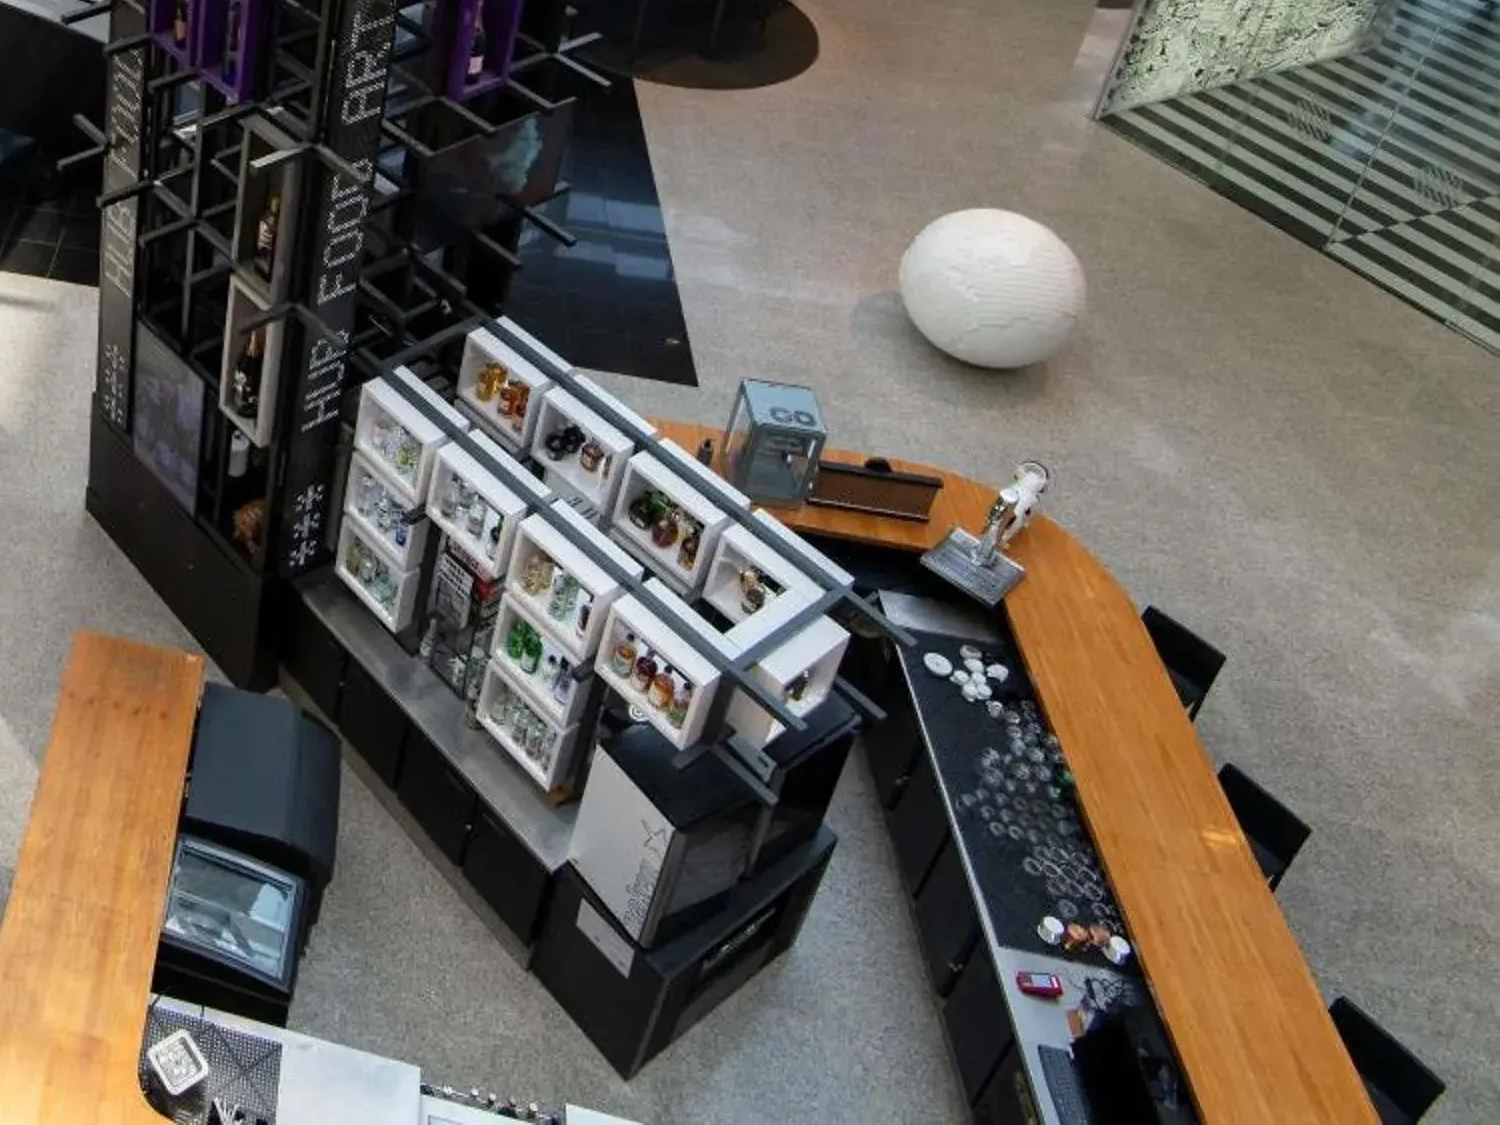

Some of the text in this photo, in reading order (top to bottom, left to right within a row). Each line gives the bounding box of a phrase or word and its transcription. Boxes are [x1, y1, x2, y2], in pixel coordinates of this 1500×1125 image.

[341, 10, 397, 125] ART
[104, 201, 134, 297] HUB
[316, 158, 373, 305] FOOD
[301, 328, 350, 432] HUB
